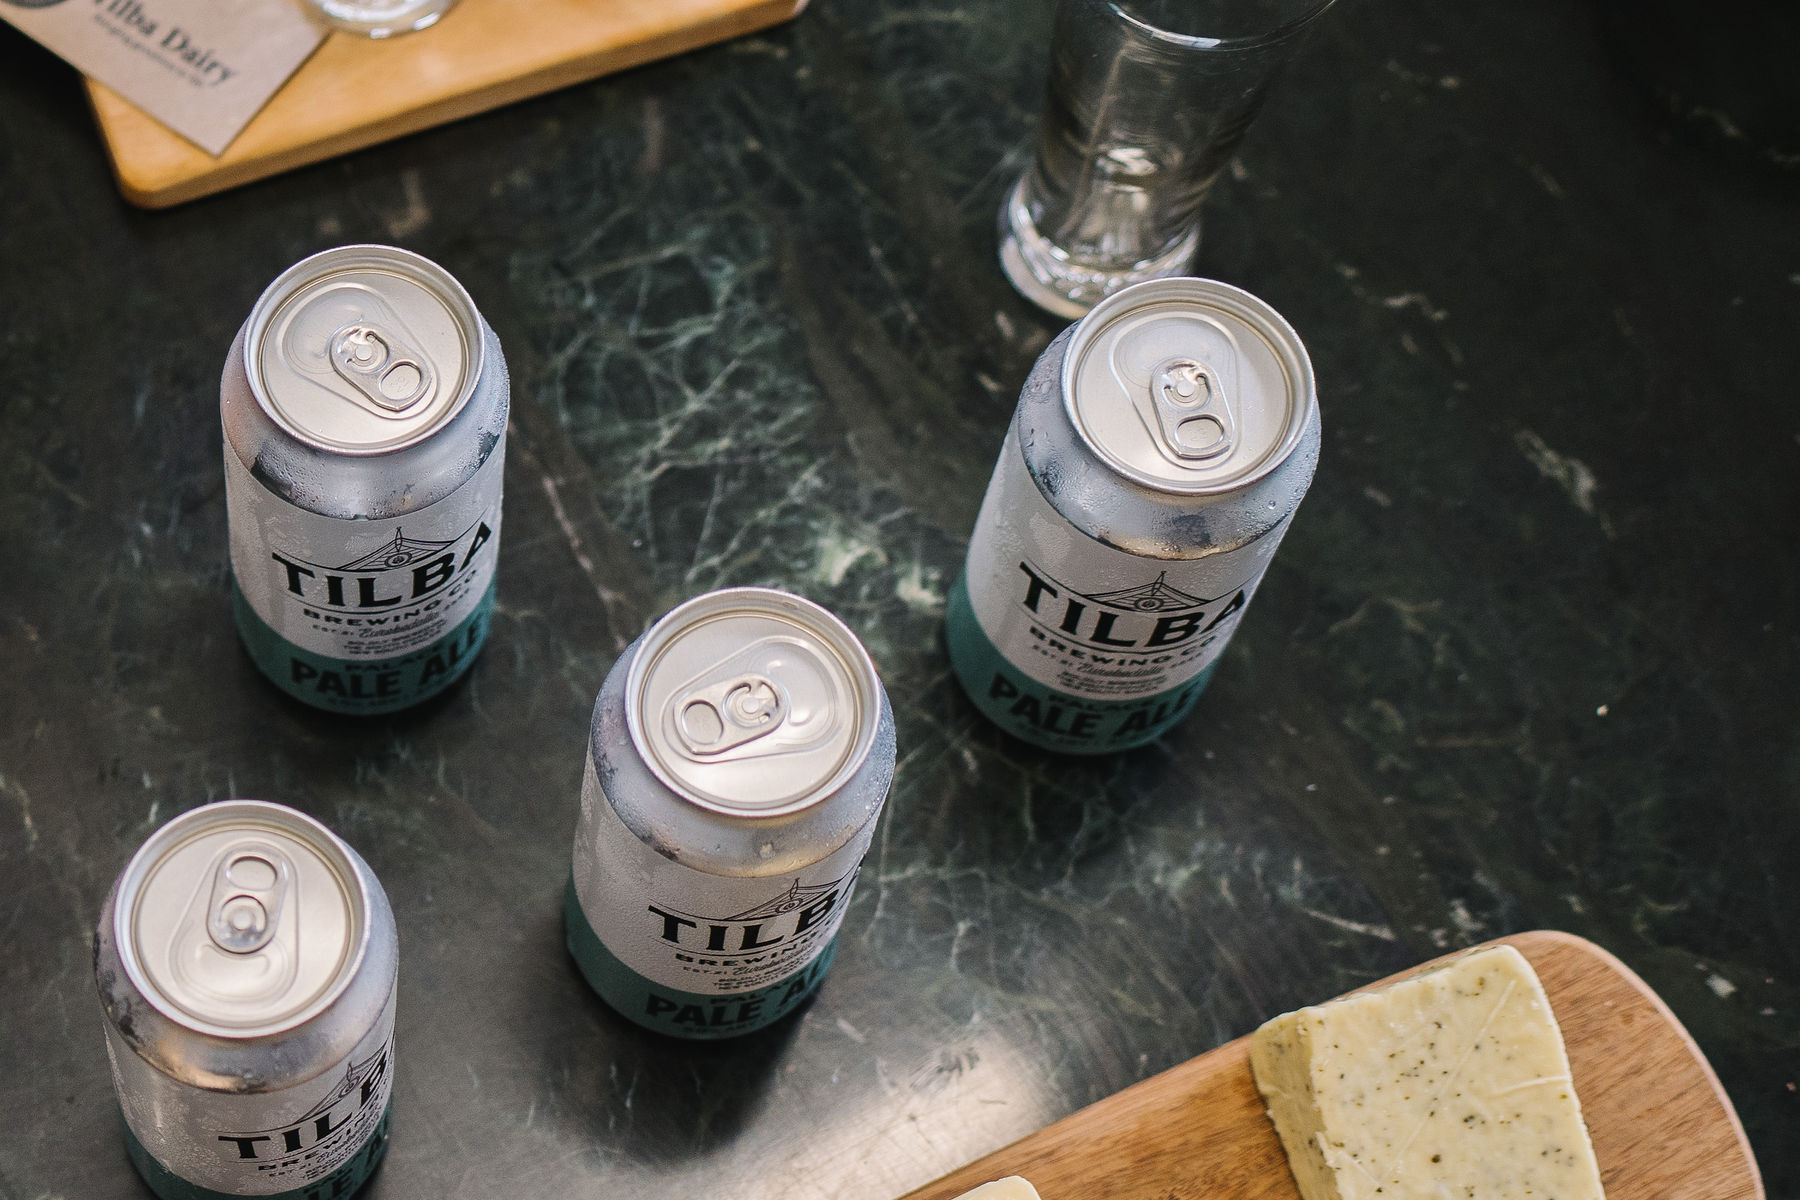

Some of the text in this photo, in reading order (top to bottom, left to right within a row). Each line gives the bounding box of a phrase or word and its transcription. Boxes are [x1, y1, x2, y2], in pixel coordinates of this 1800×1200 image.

[161, 27, 236, 88] Dairy
[272, 521, 492, 608] TILBA
[303, 600, 442, 627] BREWING
[1018, 561, 1246, 648] TILBA
[291, 657, 401, 698] PALE
[419, 613, 489, 687] ALE
[1029, 625, 1174, 667] BREWING
[988, 672, 1106, 739] PALE
[646, 993, 762, 1028] PALE
